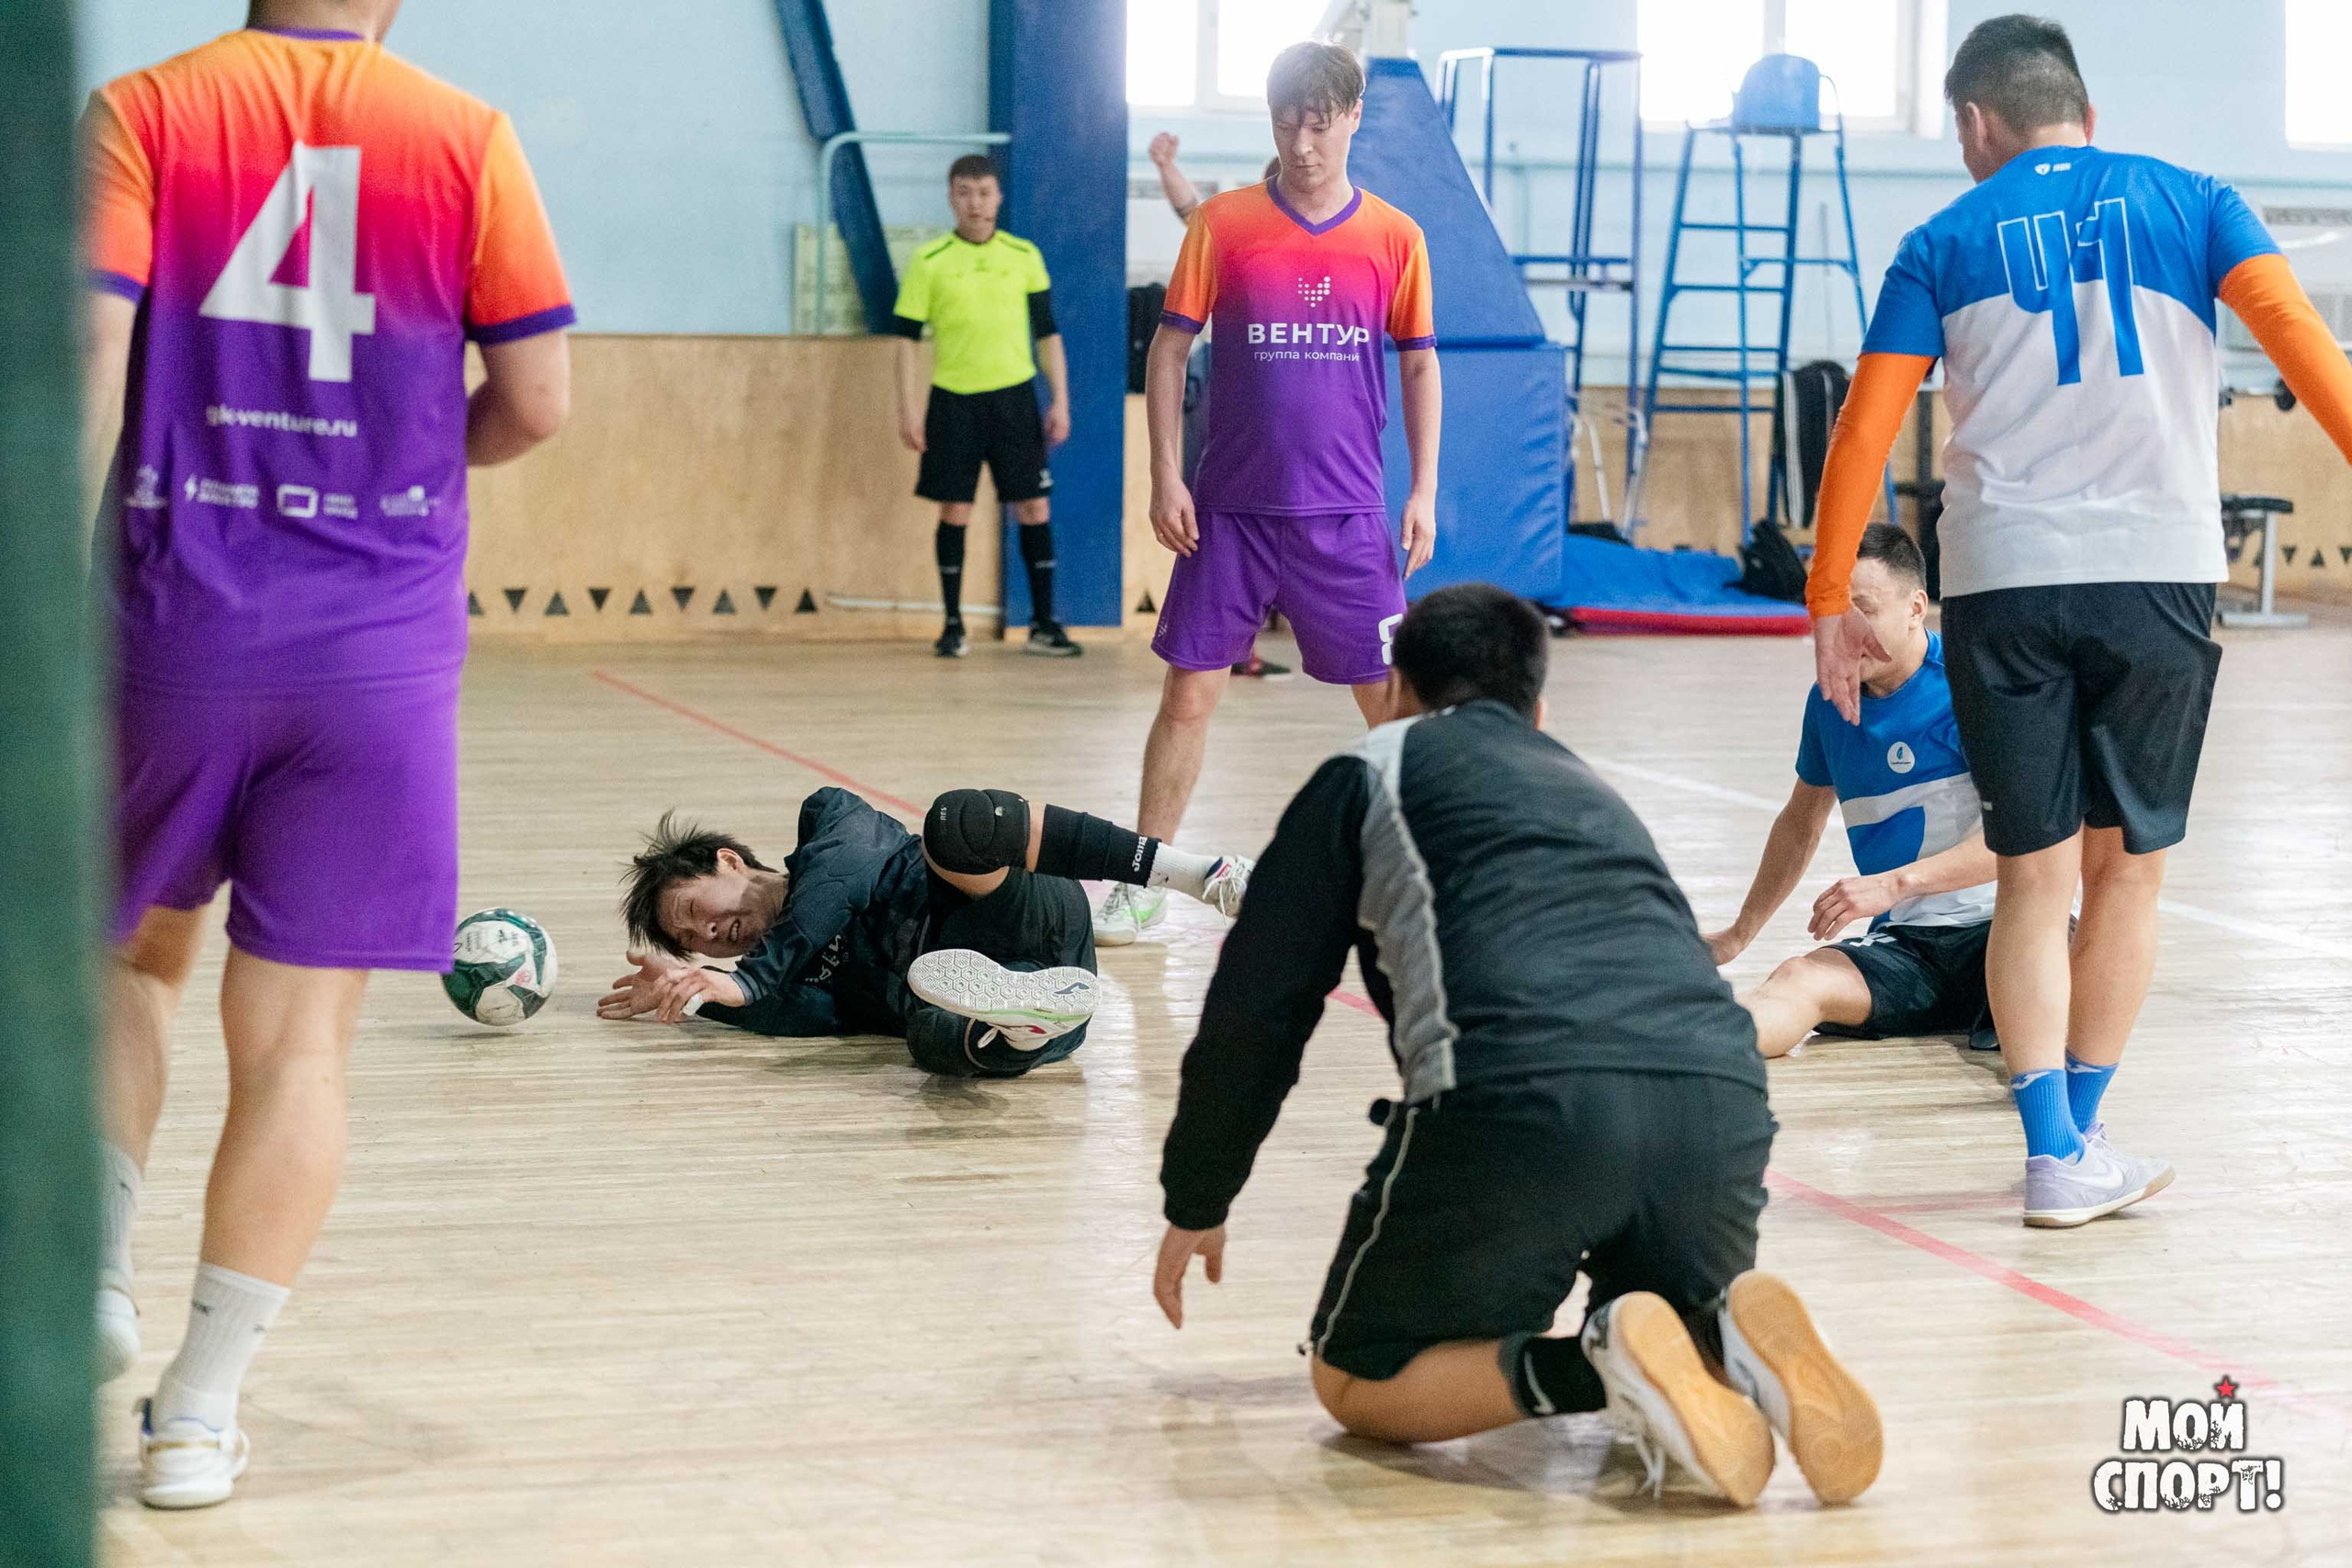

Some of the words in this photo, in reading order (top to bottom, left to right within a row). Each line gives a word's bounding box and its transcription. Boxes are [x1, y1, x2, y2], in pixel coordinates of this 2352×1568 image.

[198, 140, 376, 383] 4
[1996, 197, 2144, 386] 41
[1248, 322, 1370, 346] ВЕНТУР
[1254, 350, 1300, 362] группа
[1132, 836, 1148, 873] Joma
